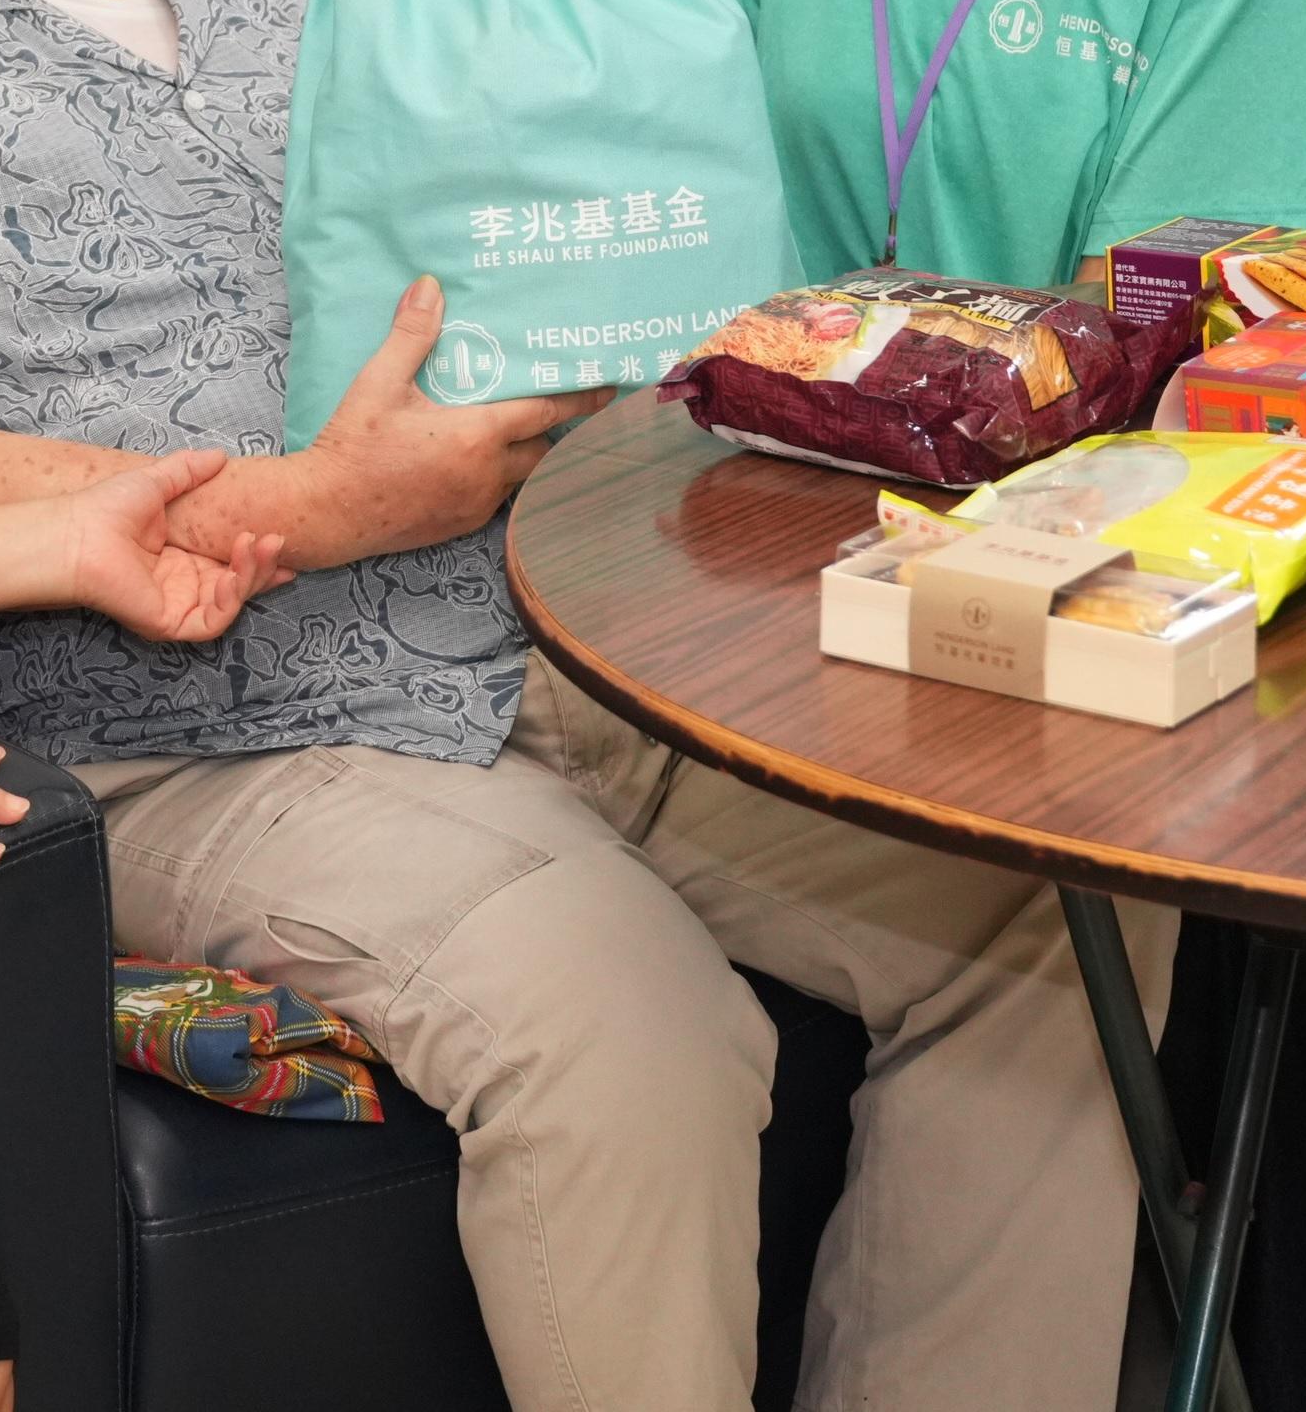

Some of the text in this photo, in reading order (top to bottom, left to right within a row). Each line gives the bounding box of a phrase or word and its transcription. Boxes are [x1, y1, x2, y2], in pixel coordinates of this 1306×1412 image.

[469, 185, 708, 248] 李兆基基金
[473, 231, 709, 269] LEE SHAU KEE FOUNDATION
[527, 315, 684, 349] HENDERSON
[435, 353, 492, 375] 恒 基
